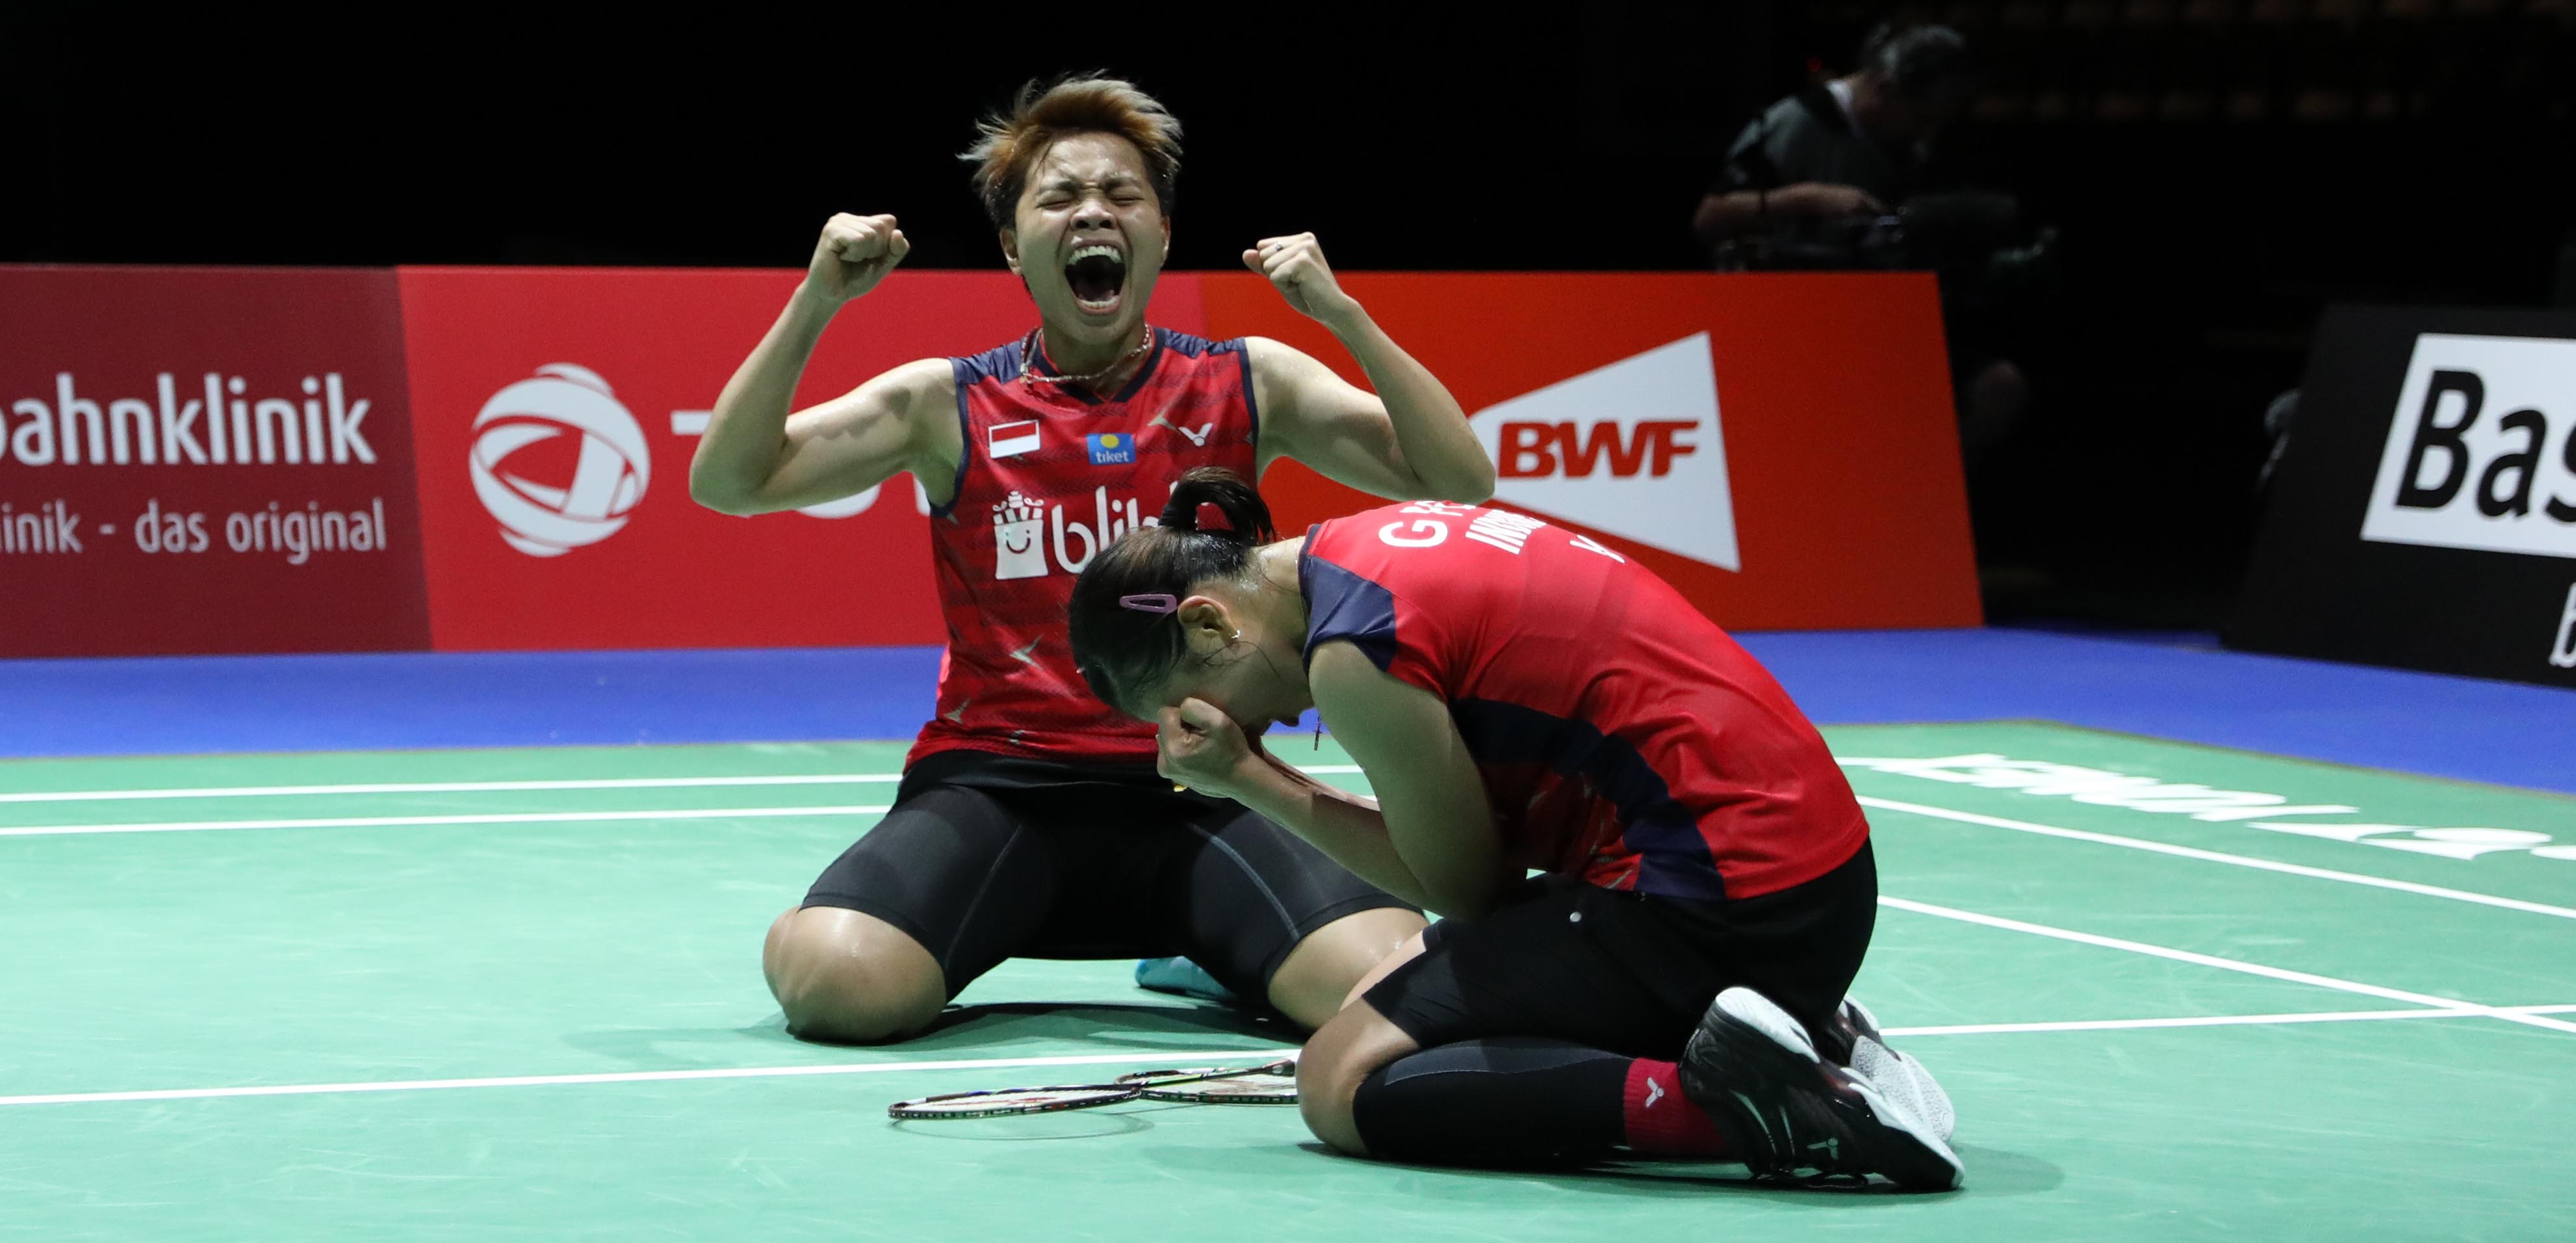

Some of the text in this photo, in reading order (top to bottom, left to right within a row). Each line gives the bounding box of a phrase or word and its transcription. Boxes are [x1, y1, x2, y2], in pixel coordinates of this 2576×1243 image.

[0, 372, 377, 465] ahnklinik
[1497, 420, 1699, 478] BWF
[1096, 450, 1129, 464] tiket
[134, 498, 211, 554] das
[225, 497, 387, 565] original
